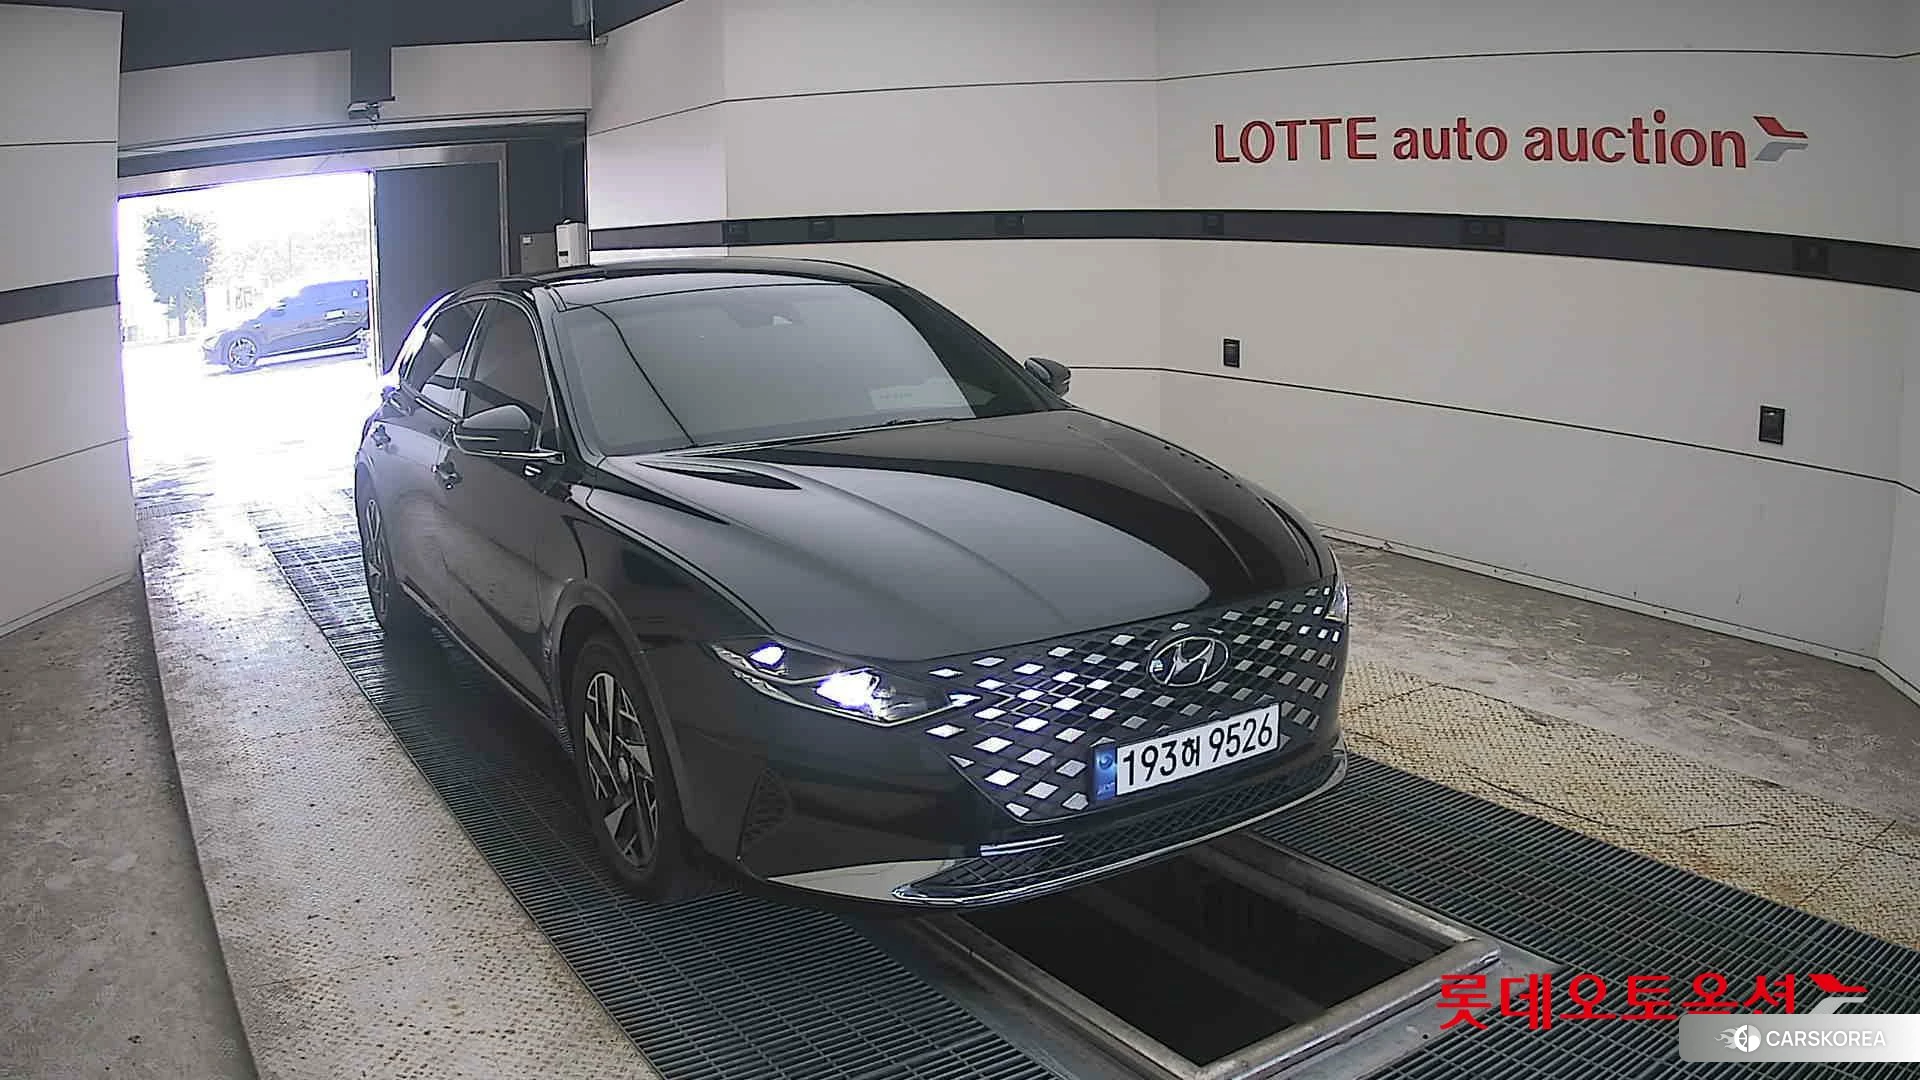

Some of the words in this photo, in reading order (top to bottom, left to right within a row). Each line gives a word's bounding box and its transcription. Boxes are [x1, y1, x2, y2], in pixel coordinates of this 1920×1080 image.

[1214, 115, 1377, 164] LOTTE
[1392, 117, 1509, 162] auto
[1523, 109, 1748, 169] auction
[1122, 735, 1201, 786] 193허
[1208, 712, 1273, 763] 9526
